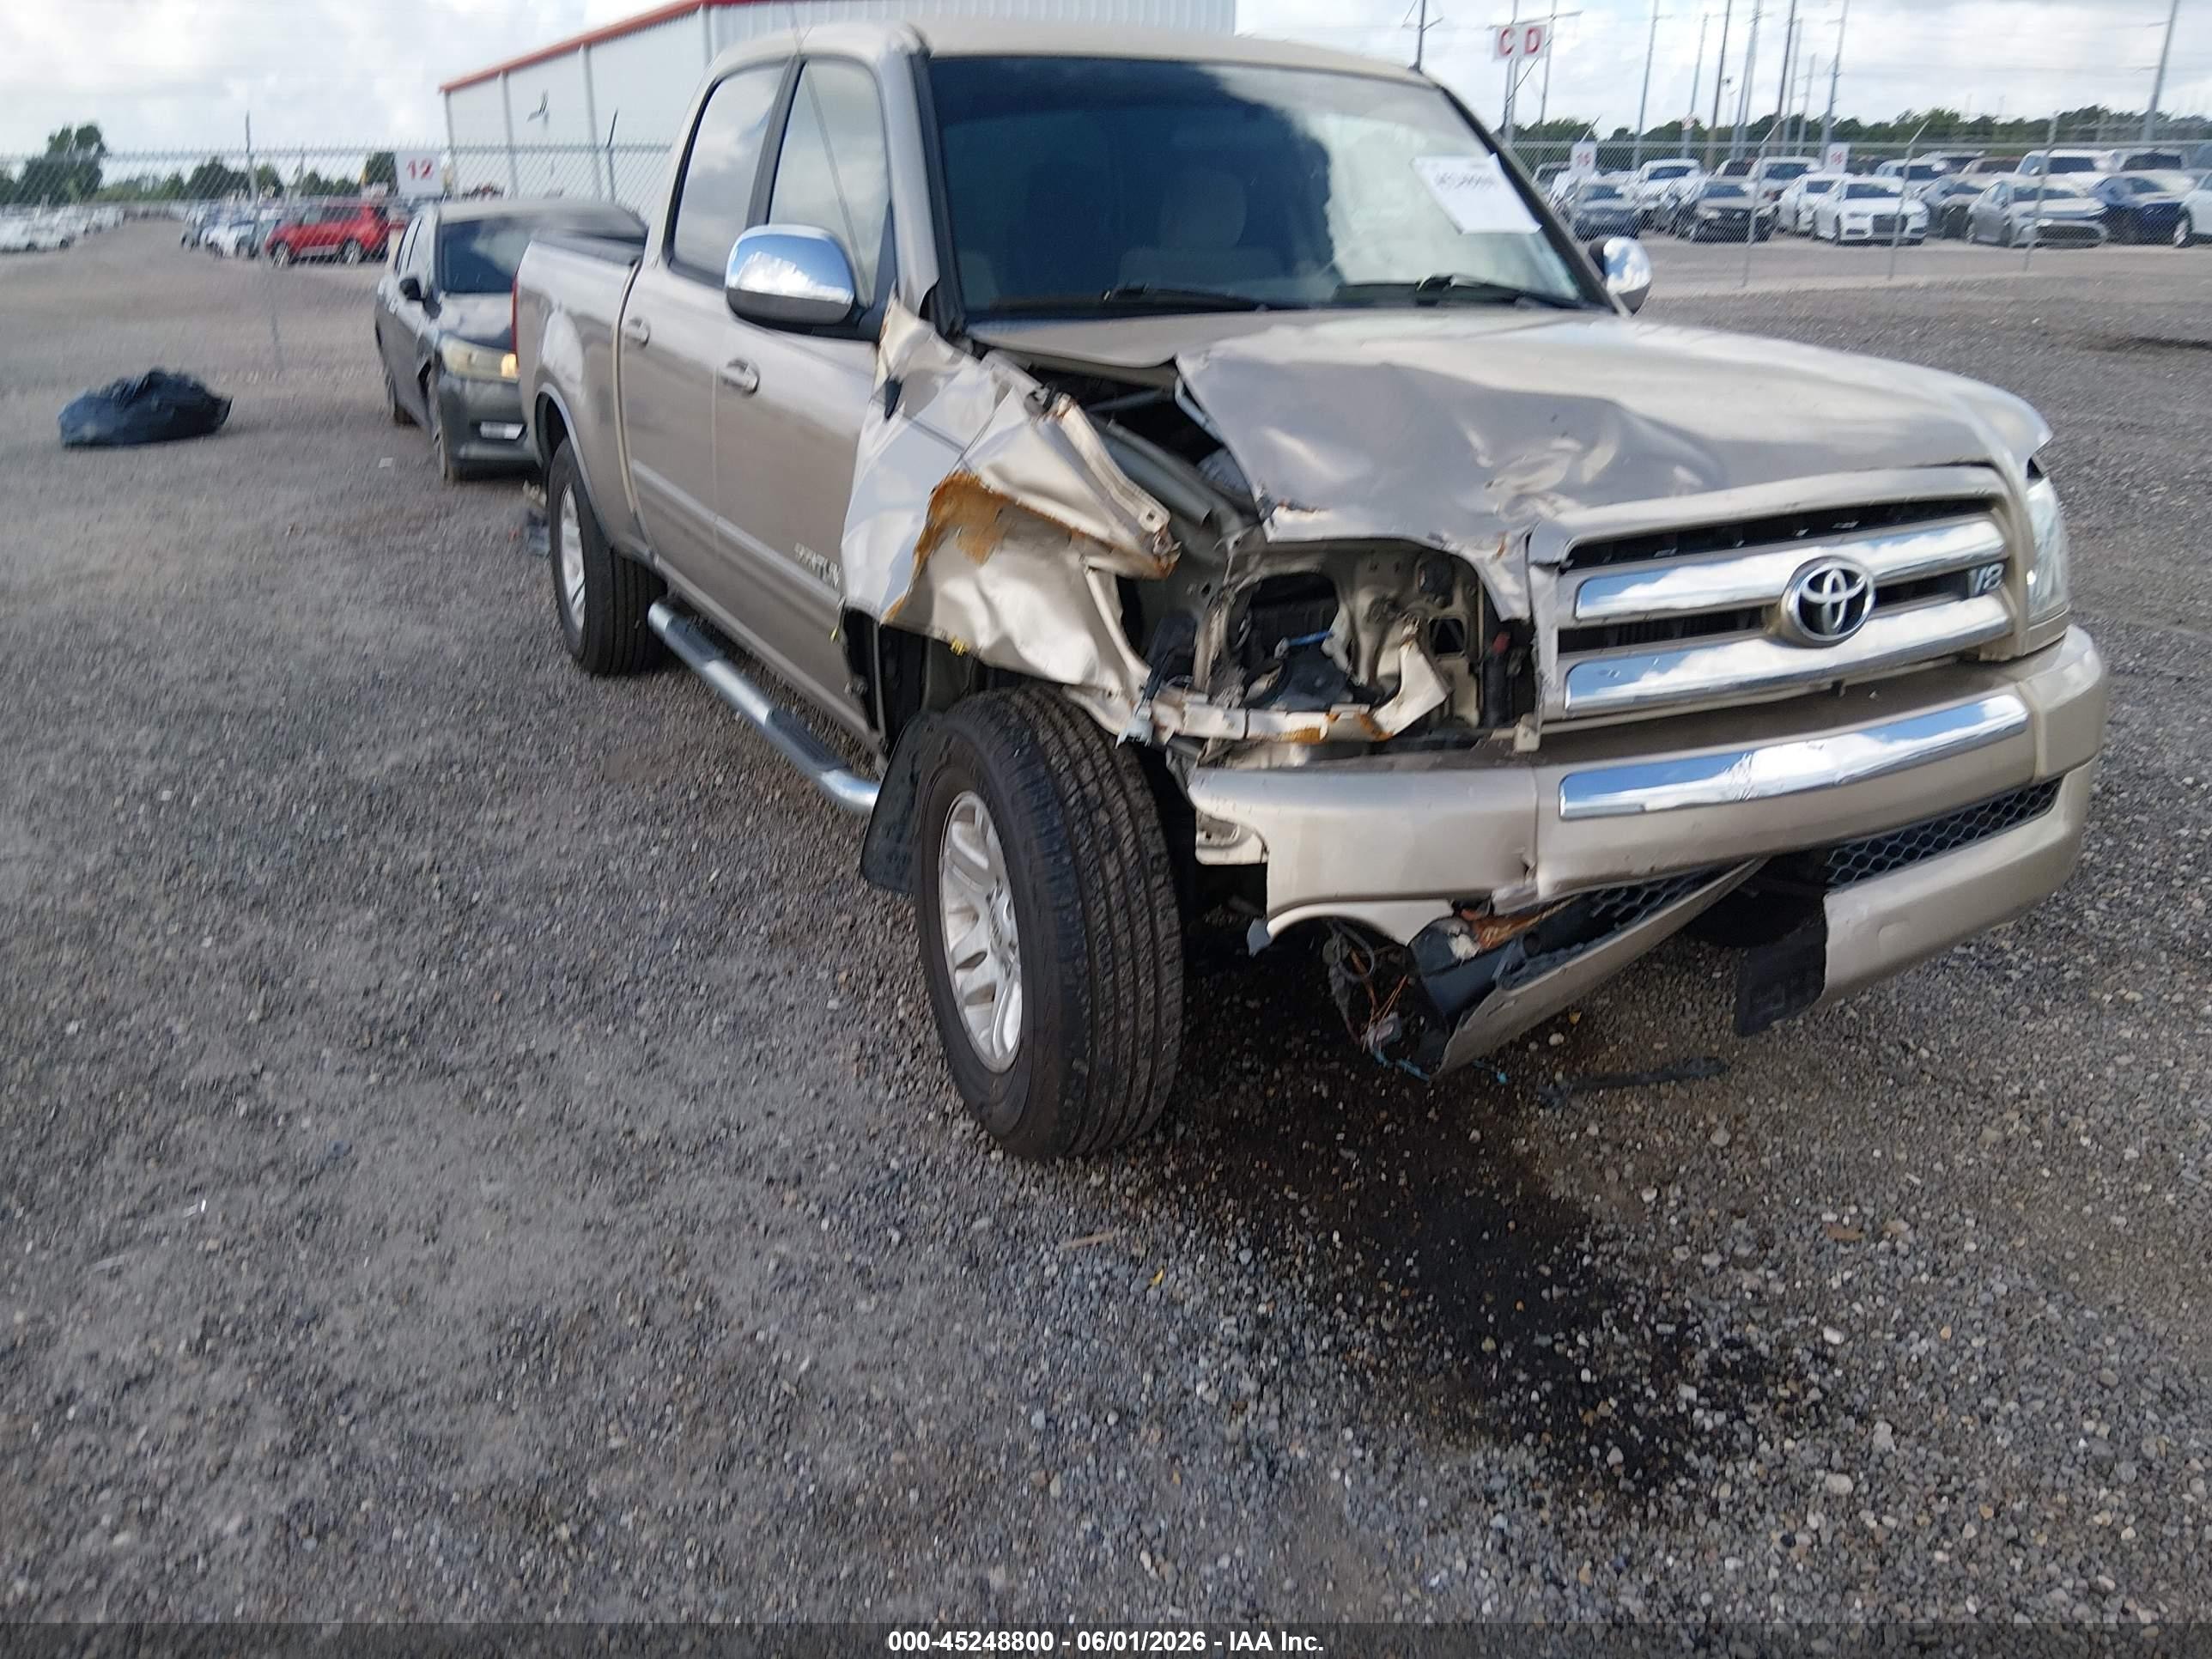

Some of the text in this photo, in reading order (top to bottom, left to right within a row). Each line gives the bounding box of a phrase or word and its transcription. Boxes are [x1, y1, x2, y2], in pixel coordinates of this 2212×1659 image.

[1498, 27, 1542, 57] C D
[406, 157, 434, 180] 12
[1967, 562, 2005, 598] V8
